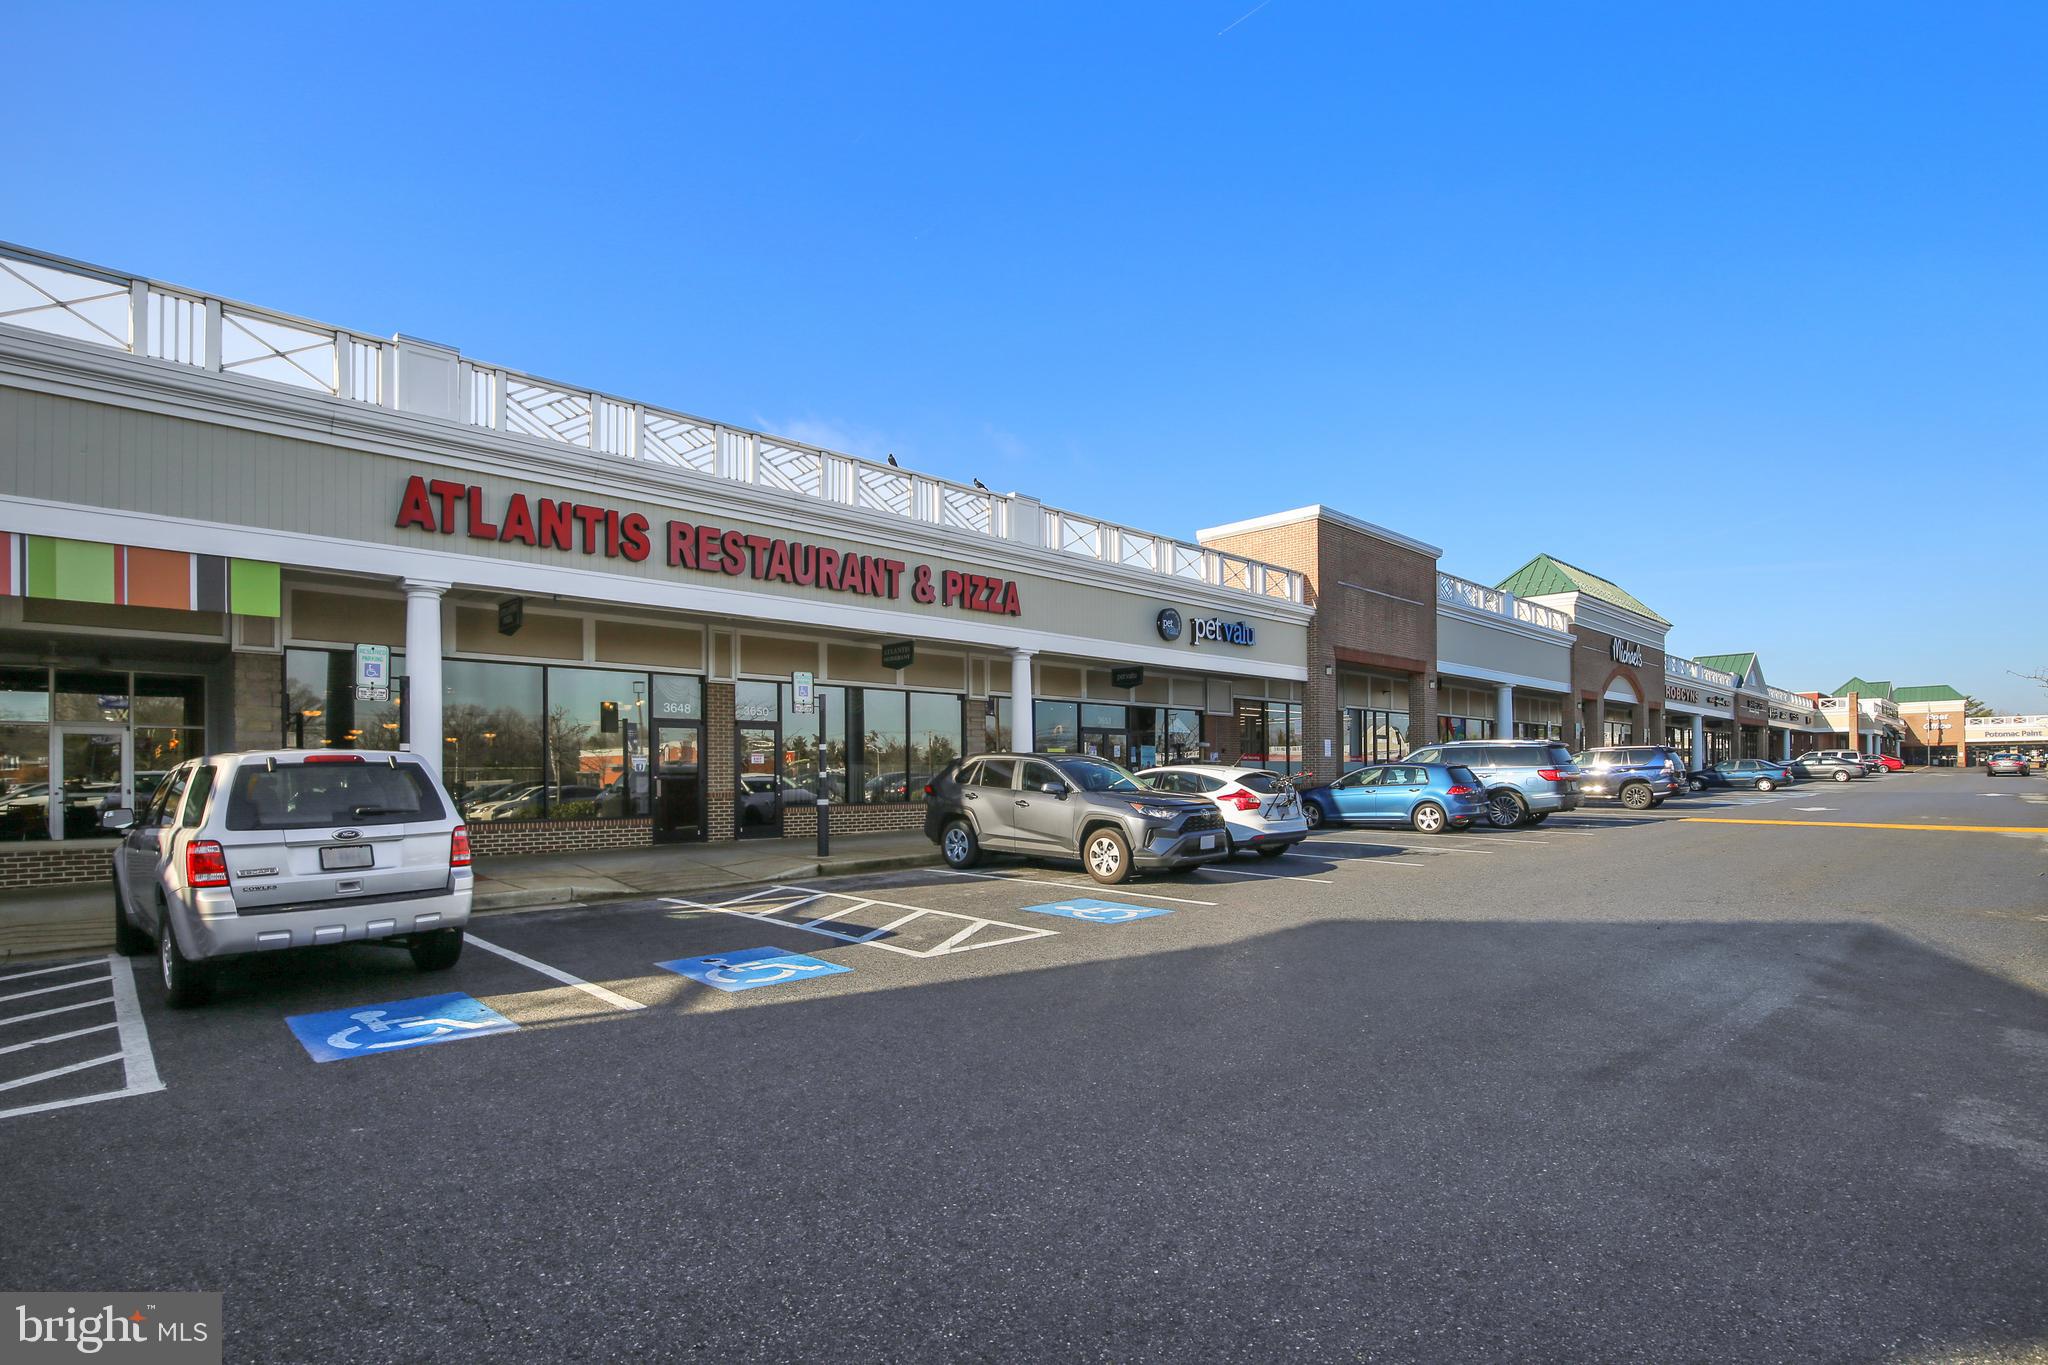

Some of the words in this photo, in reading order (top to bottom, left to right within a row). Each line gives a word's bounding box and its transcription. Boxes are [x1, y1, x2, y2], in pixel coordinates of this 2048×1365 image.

[394, 475, 650, 562] ATLANTIS
[666, 519, 905, 600] RESTAURANT
[912, 564, 936, 604] &
[942, 569, 1022, 617] PIZZA
[1162, 618, 1174, 629] pet
[1191, 617, 1221, 646] pet
[1222, 620, 1257, 646] valu
[1611, 637, 1643, 668] Michaels
[663, 702, 691, 714] 3648
[743, 706, 769, 716] 3650
[1926, 713, 1949, 721] Post
[1922, 722, 1952, 730] Office
[1984, 730, 2020, 738] Potomac
[2021, 730, 2043, 738] Paint
[242, 884, 277, 893] COWLES
